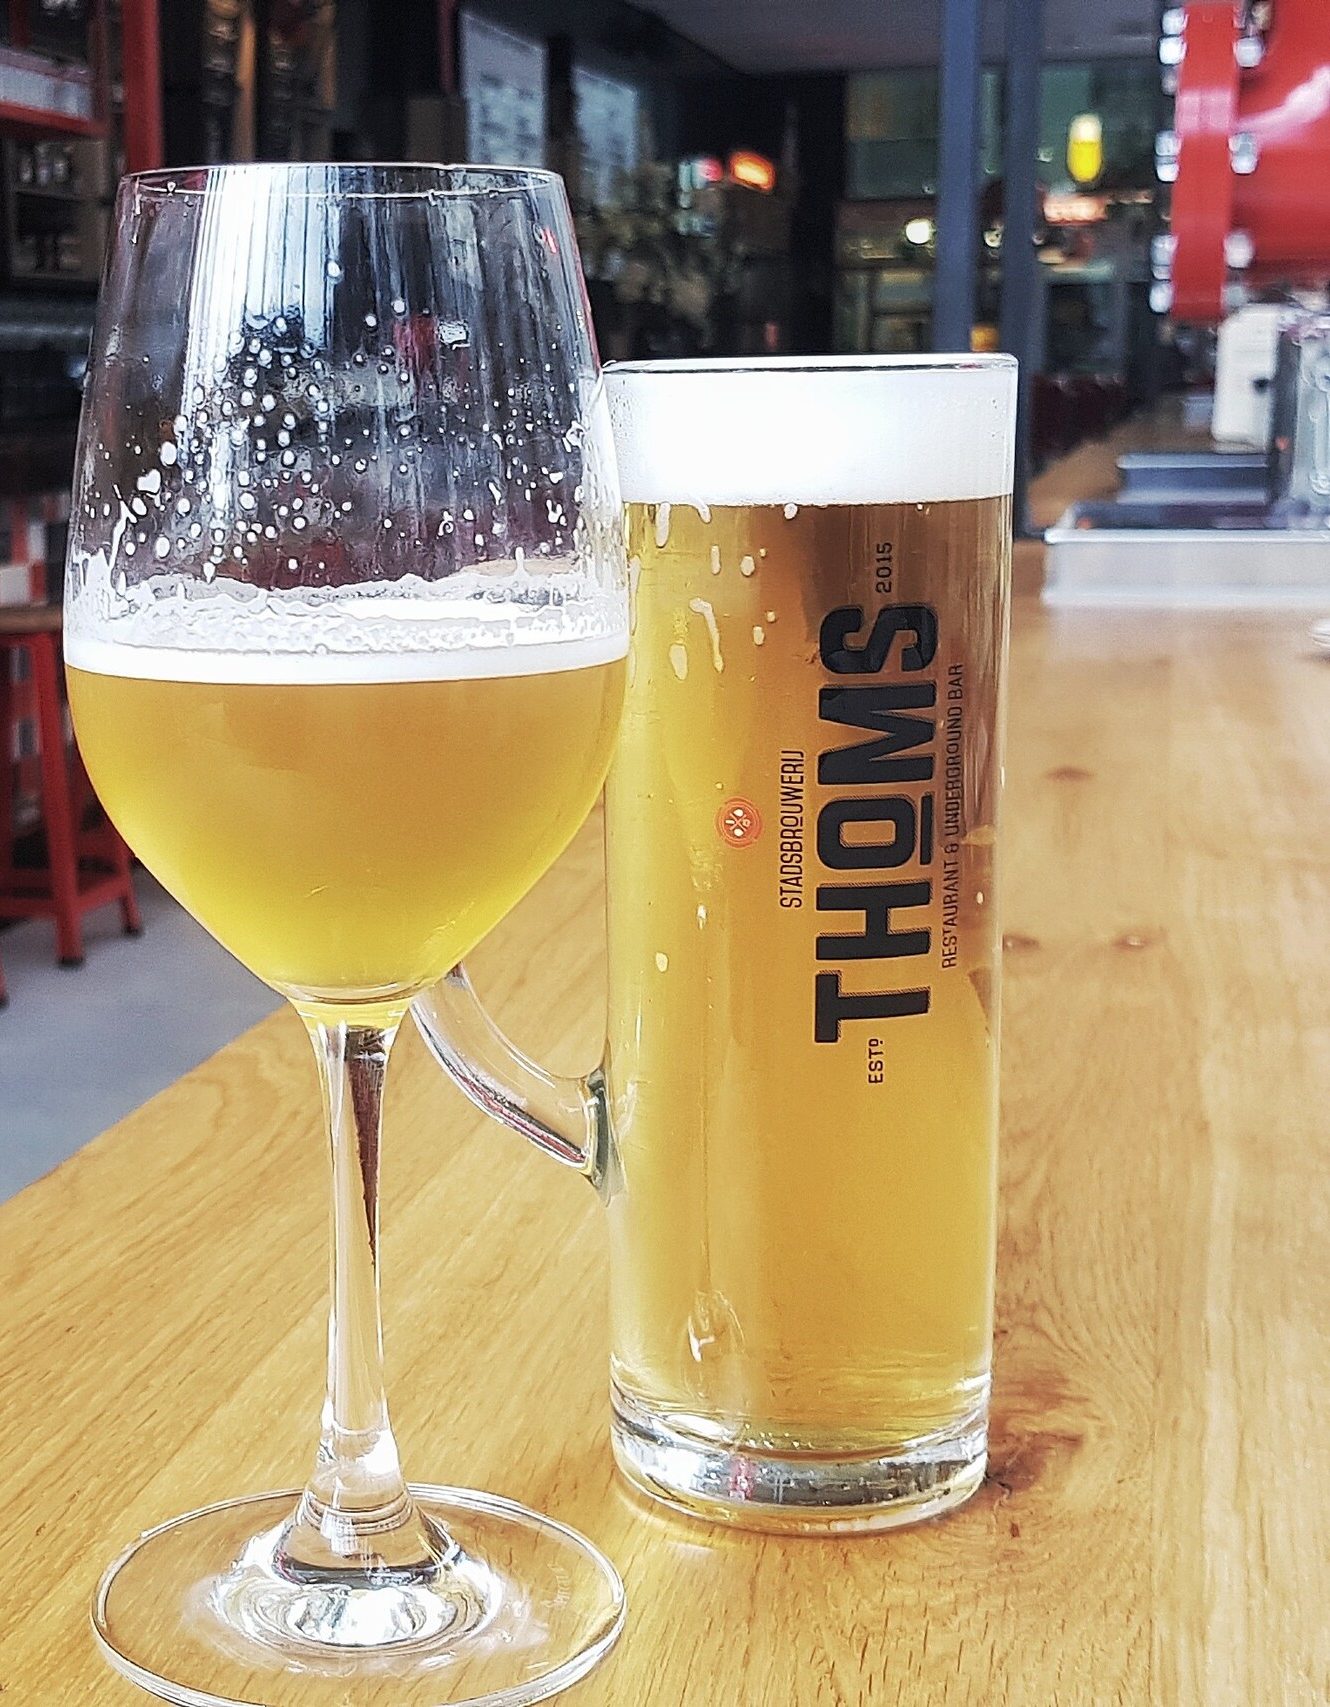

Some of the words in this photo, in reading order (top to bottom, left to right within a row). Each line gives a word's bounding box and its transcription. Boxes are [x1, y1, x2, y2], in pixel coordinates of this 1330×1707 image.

[875, 542, 893, 594] 2015
[947, 663, 965, 701] BAR
[779, 749, 805, 909] STADSBROUWERIJ
[814, 604, 939, 1044] THOMS
[944, 705, 963, 837] UNDERGROUND
[941, 861, 960, 969] RESTAURANT
